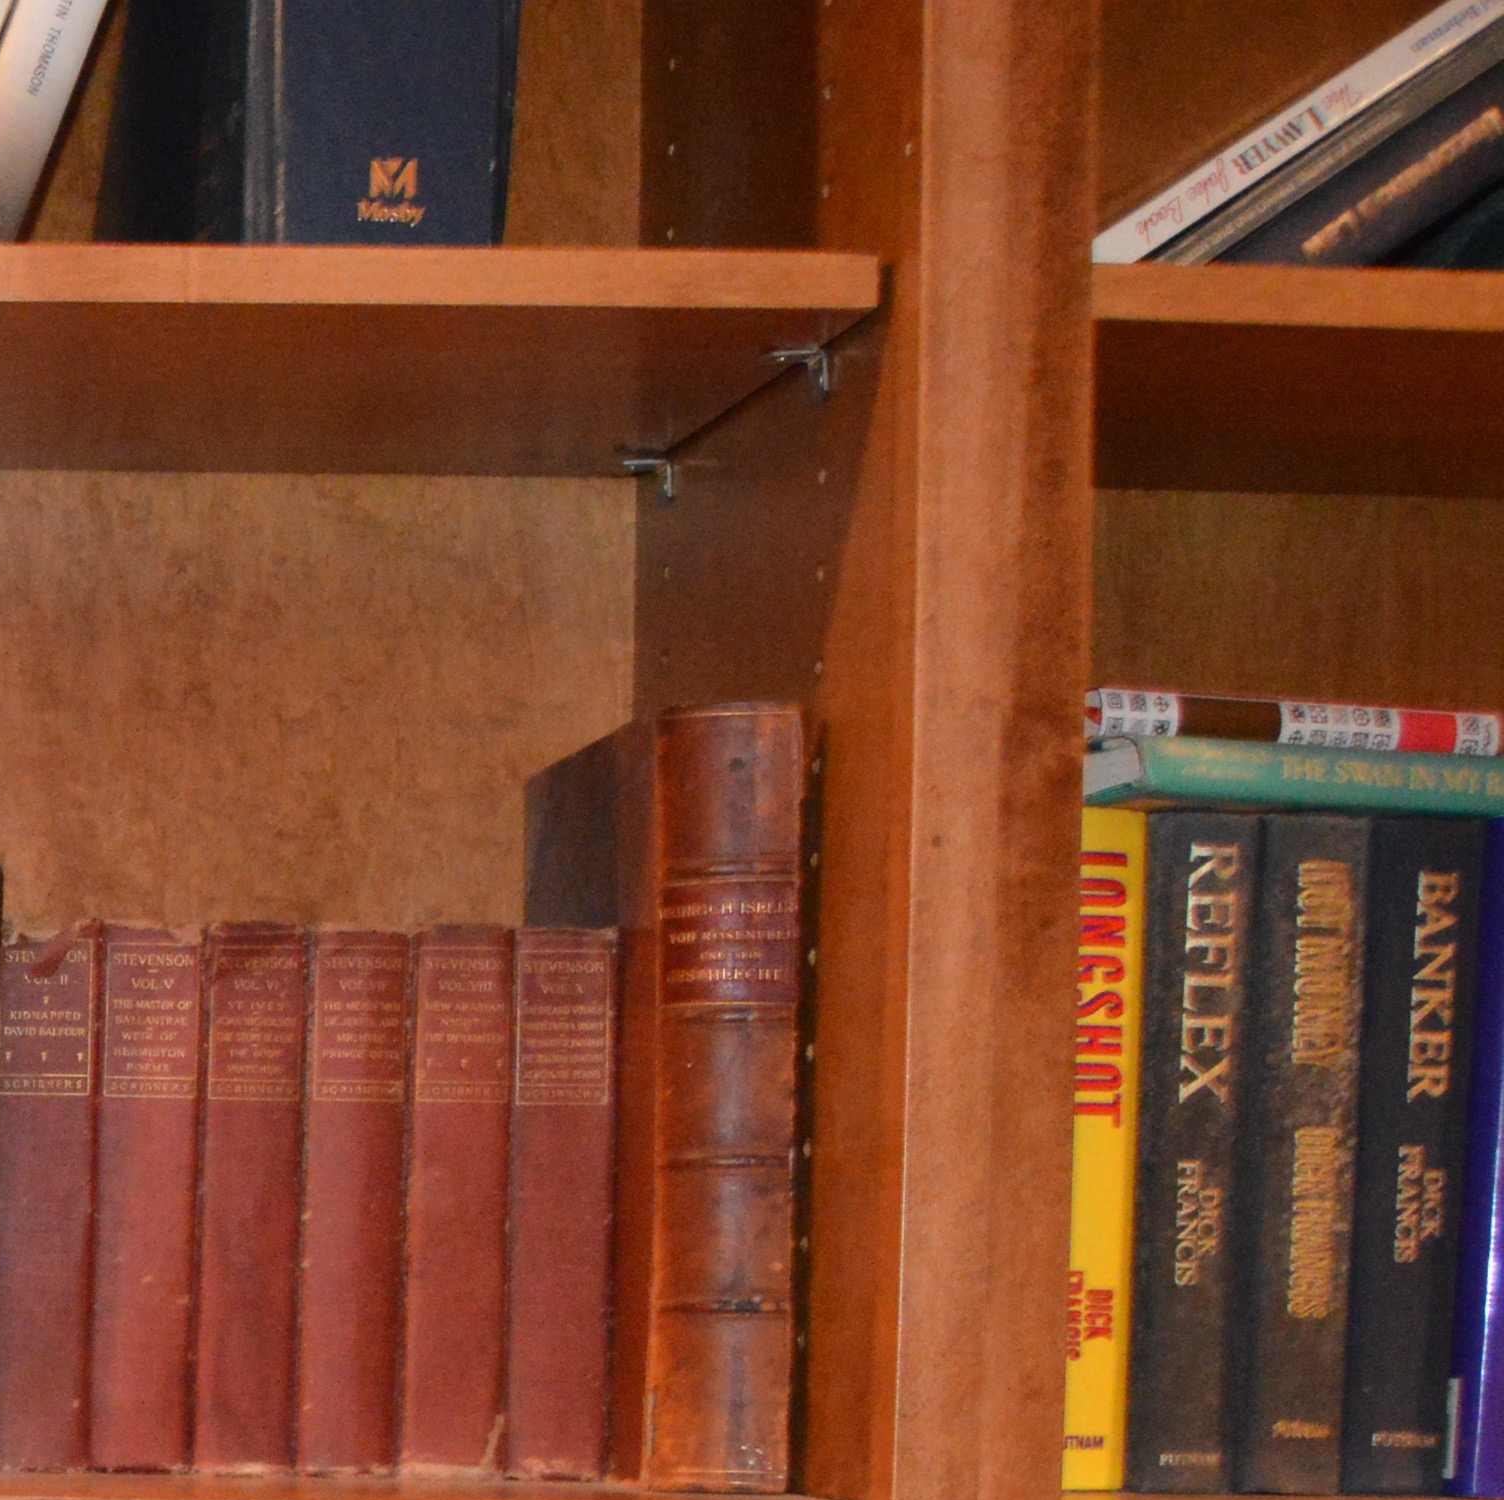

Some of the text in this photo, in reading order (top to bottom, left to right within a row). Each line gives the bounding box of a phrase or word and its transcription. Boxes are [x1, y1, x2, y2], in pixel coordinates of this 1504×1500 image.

[1177, 840, 1239, 1104] REFLEX
[1405, 869, 1459, 1104] BANKER
[1173, 1158, 1201, 1287] FRANCIS
[1196, 1186, 1222, 1256] DICK
[1392, 1142, 1422, 1264] FRANCIS
[1418, 1168, 1444, 1241] DICK
